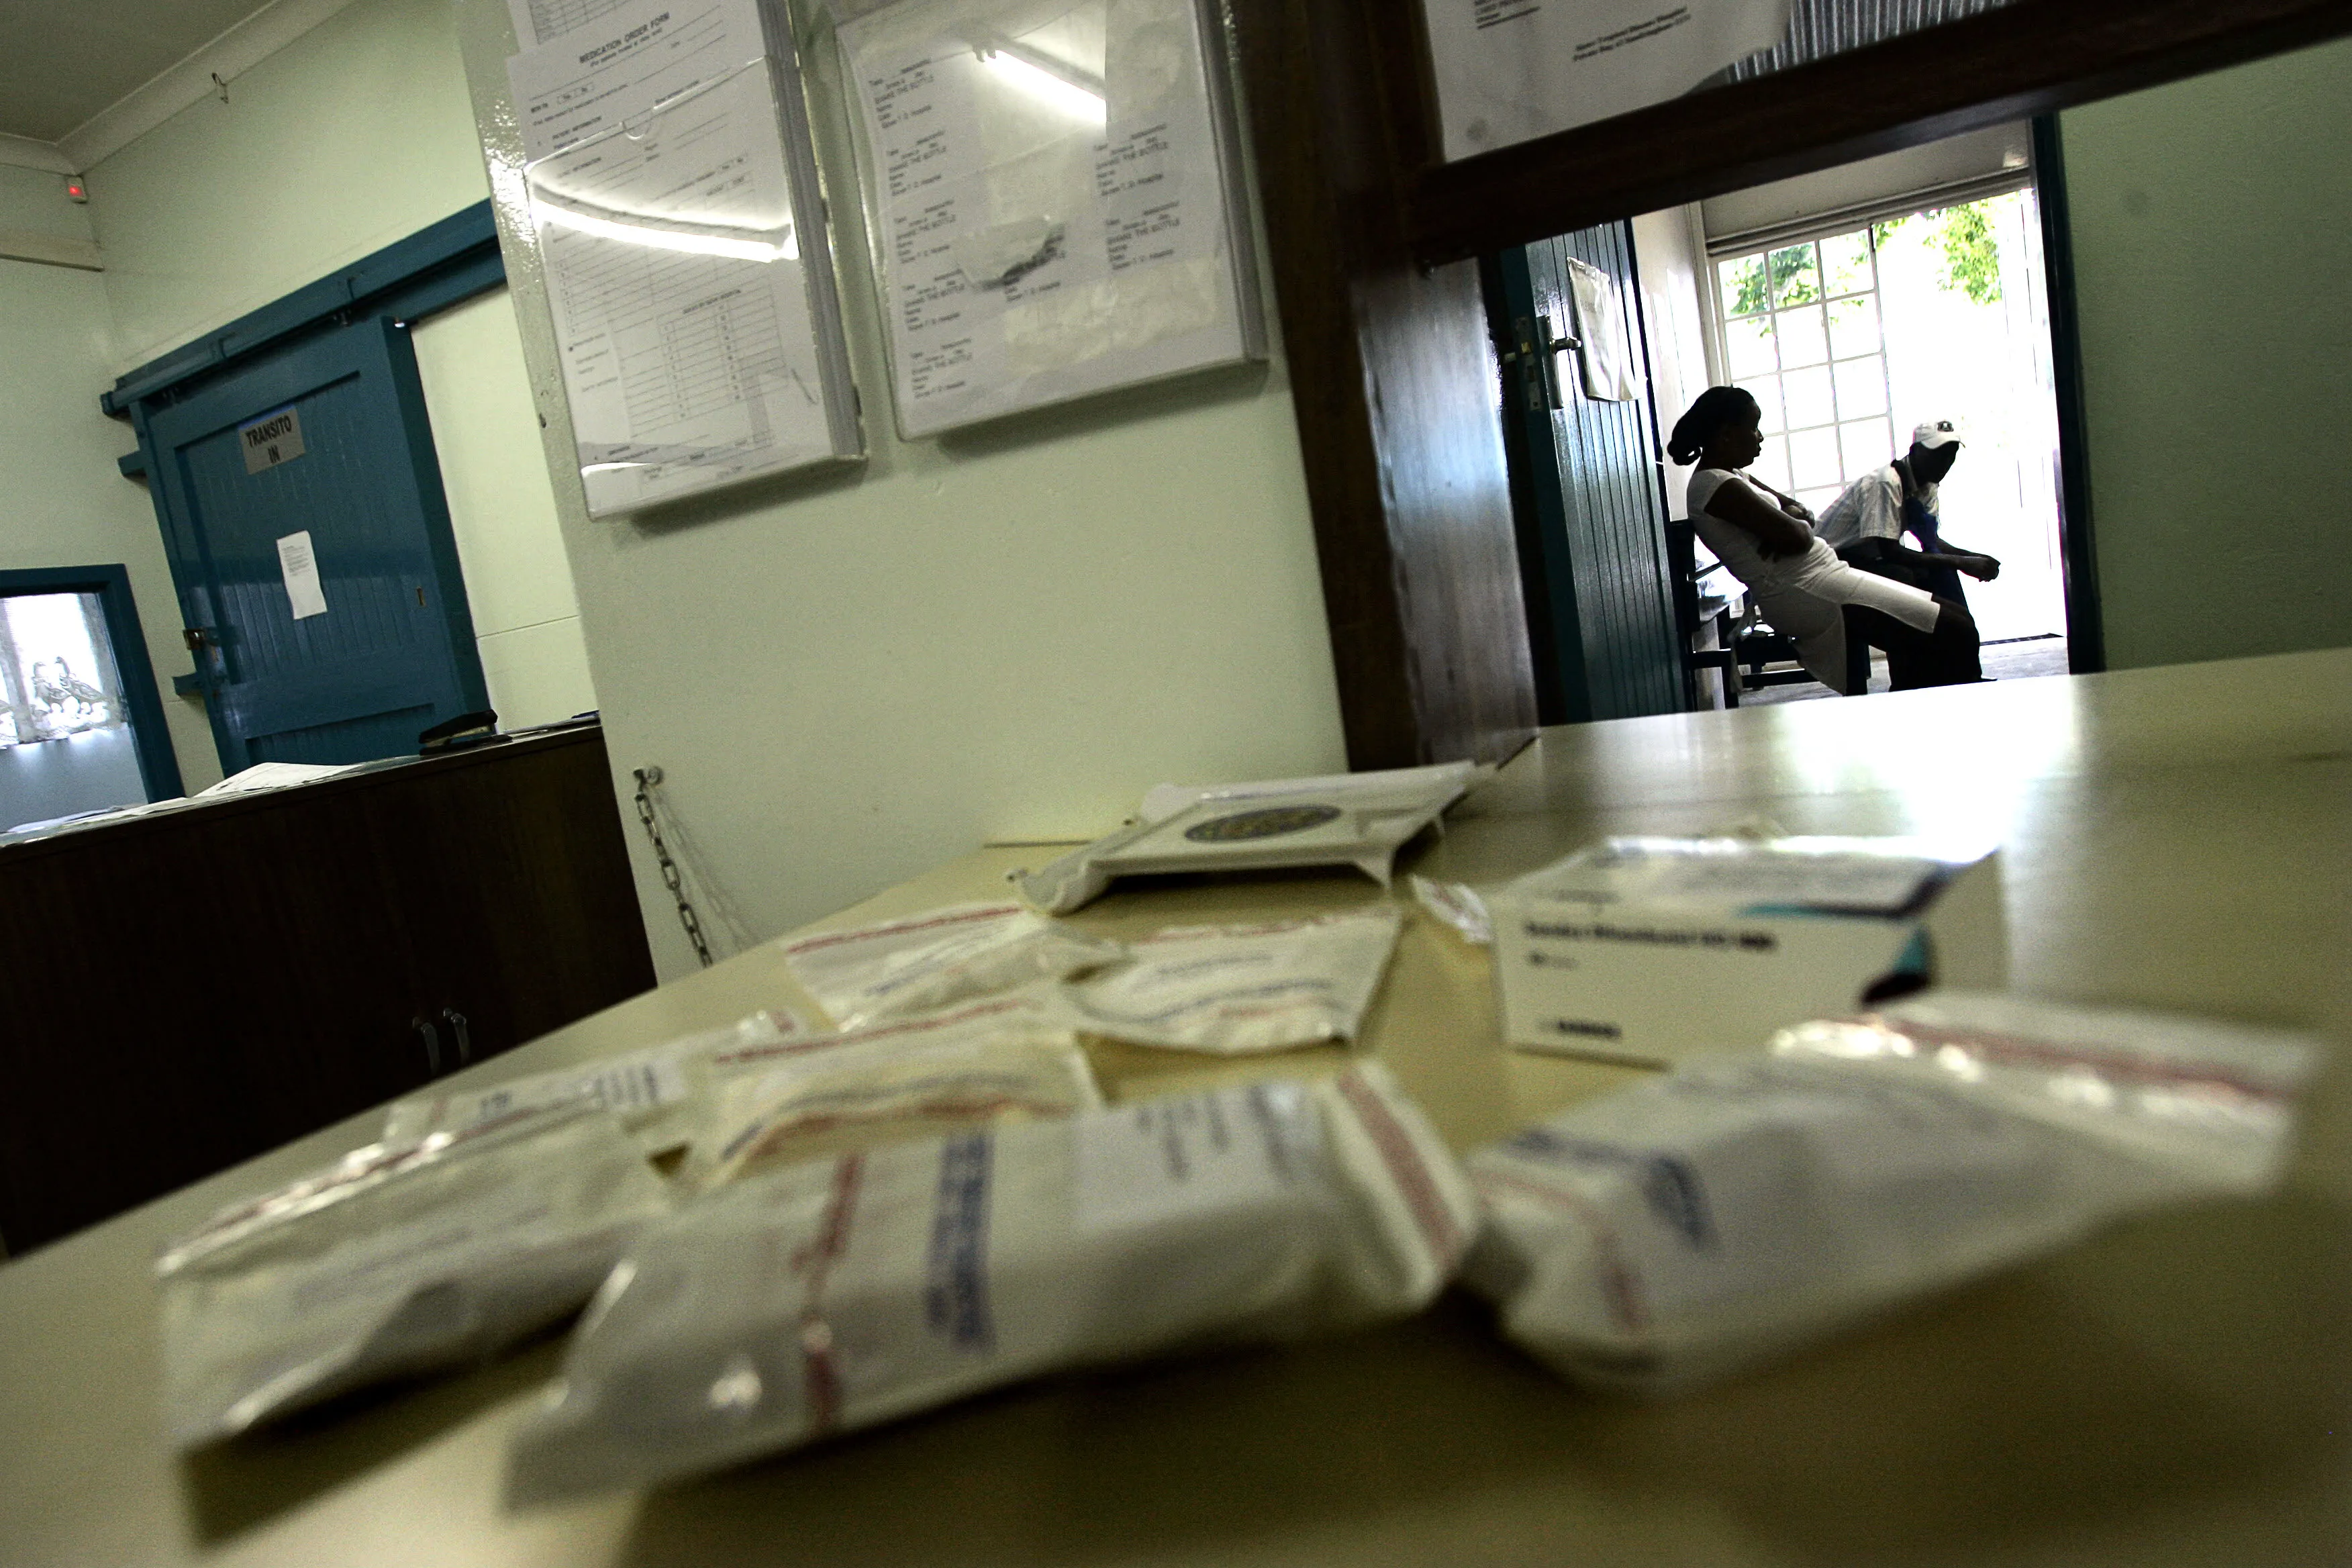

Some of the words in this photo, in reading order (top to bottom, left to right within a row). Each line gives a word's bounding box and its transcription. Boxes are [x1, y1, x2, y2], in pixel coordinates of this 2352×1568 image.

[579, 38, 622, 64] MEDICATION
[624, 23, 648, 42] ORDER
[650, 11, 669, 28] FORM
[245, 415, 292, 448] TRANSITO
[268, 444, 281, 464] IN
